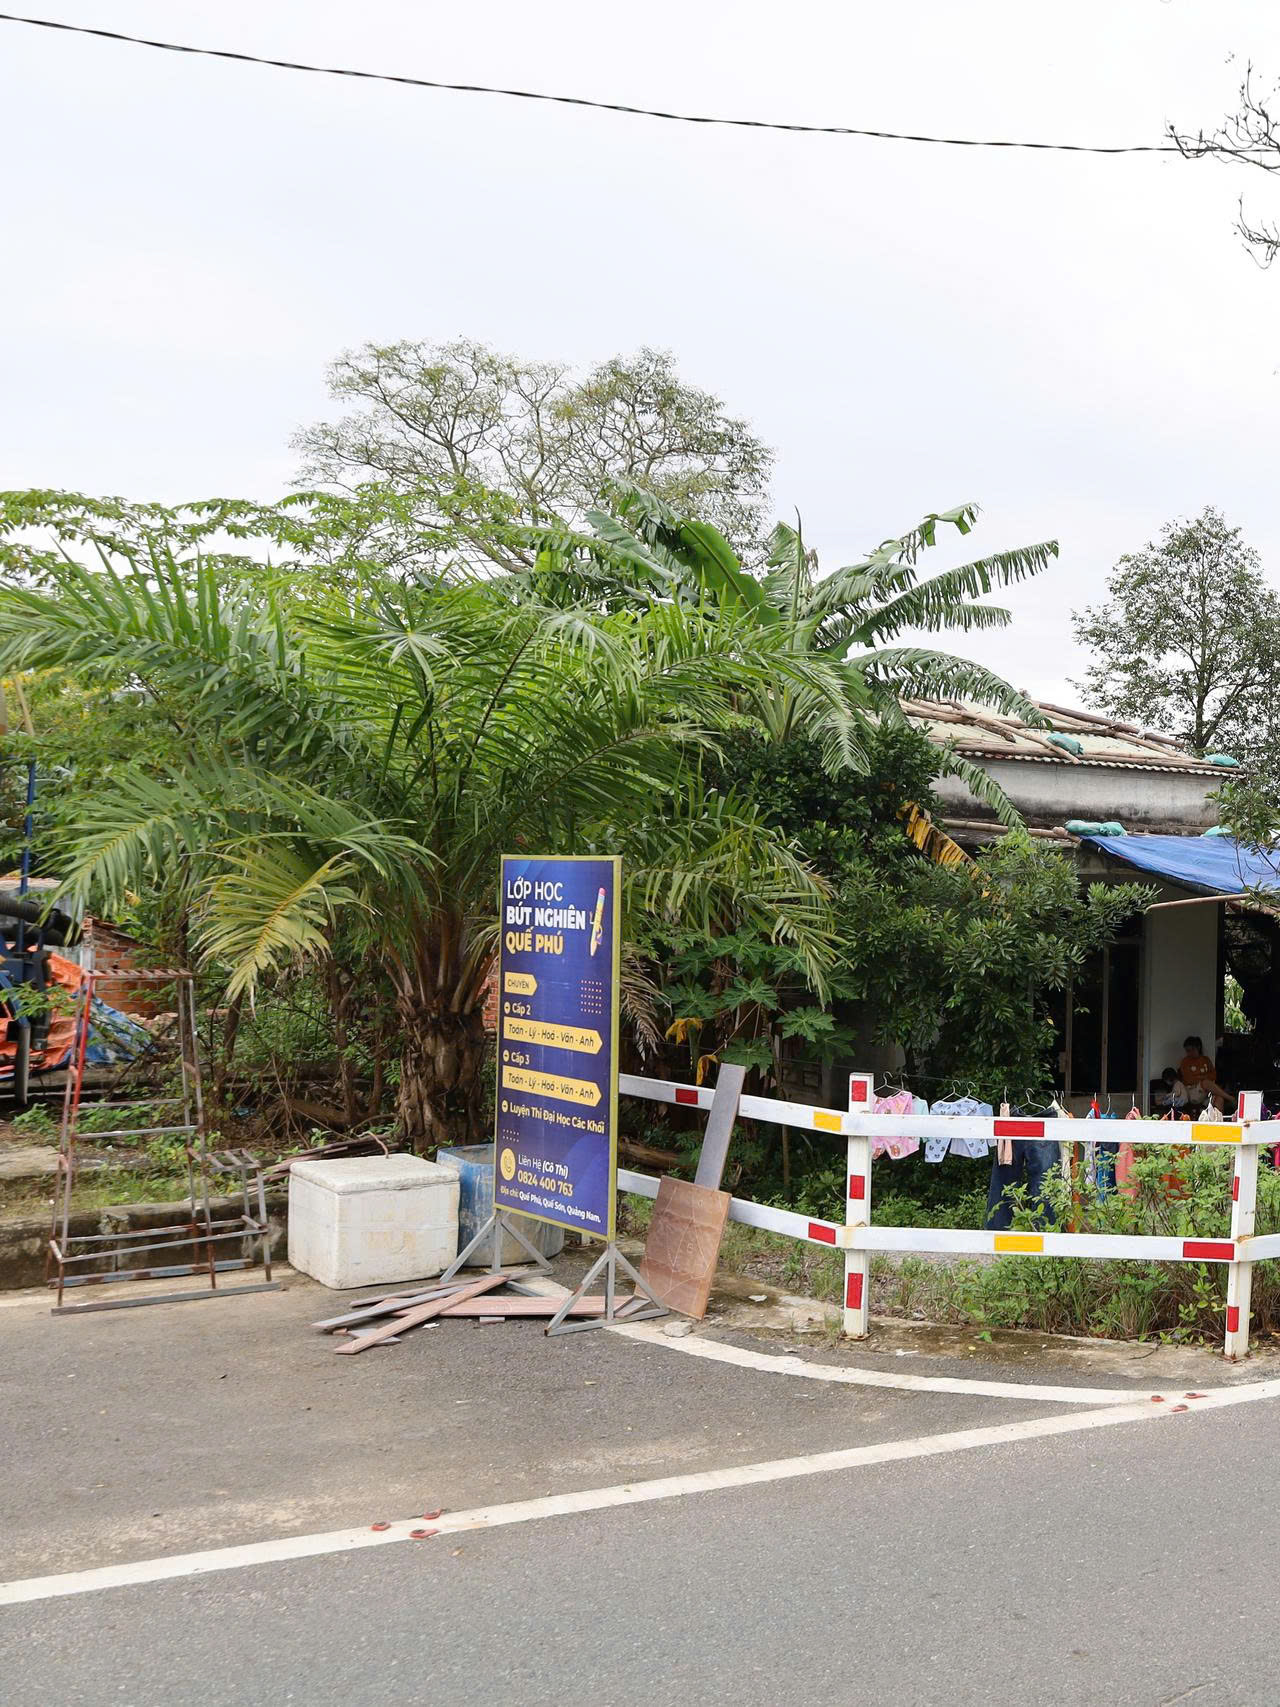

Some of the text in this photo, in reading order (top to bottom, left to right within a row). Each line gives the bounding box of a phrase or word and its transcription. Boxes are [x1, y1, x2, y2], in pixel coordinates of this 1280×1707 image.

[507, 875, 563, 906] LỚP HỌC
[506, 901, 586, 930] BÚT NGHIÊN
[505, 926, 564, 955] QUẾ PHÚ
[512, 1001, 531, 1016] Cấp 2
[508, 1023, 524, 1035] Toán
[528, 1027, 537, 1039] Lý
[560, 1032, 574, 1044] Văn
[579, 1035, 594, 1047] Anh
[510, 1051, 530, 1066] Cấp 3
[508, 1072, 524, 1084] Toán
[528, 1077, 537, 1090] Lý
[560, 1082, 574, 1096] Văn
[579, 1087, 594, 1100] Anh
[510, 1102, 605, 1134] Luyện Thi Đại Học Các Khối
[518, 1154, 569, 1180] Liên Hệ (Cô Thi)
[518, 1170, 574, 1197] 0824 400 763
